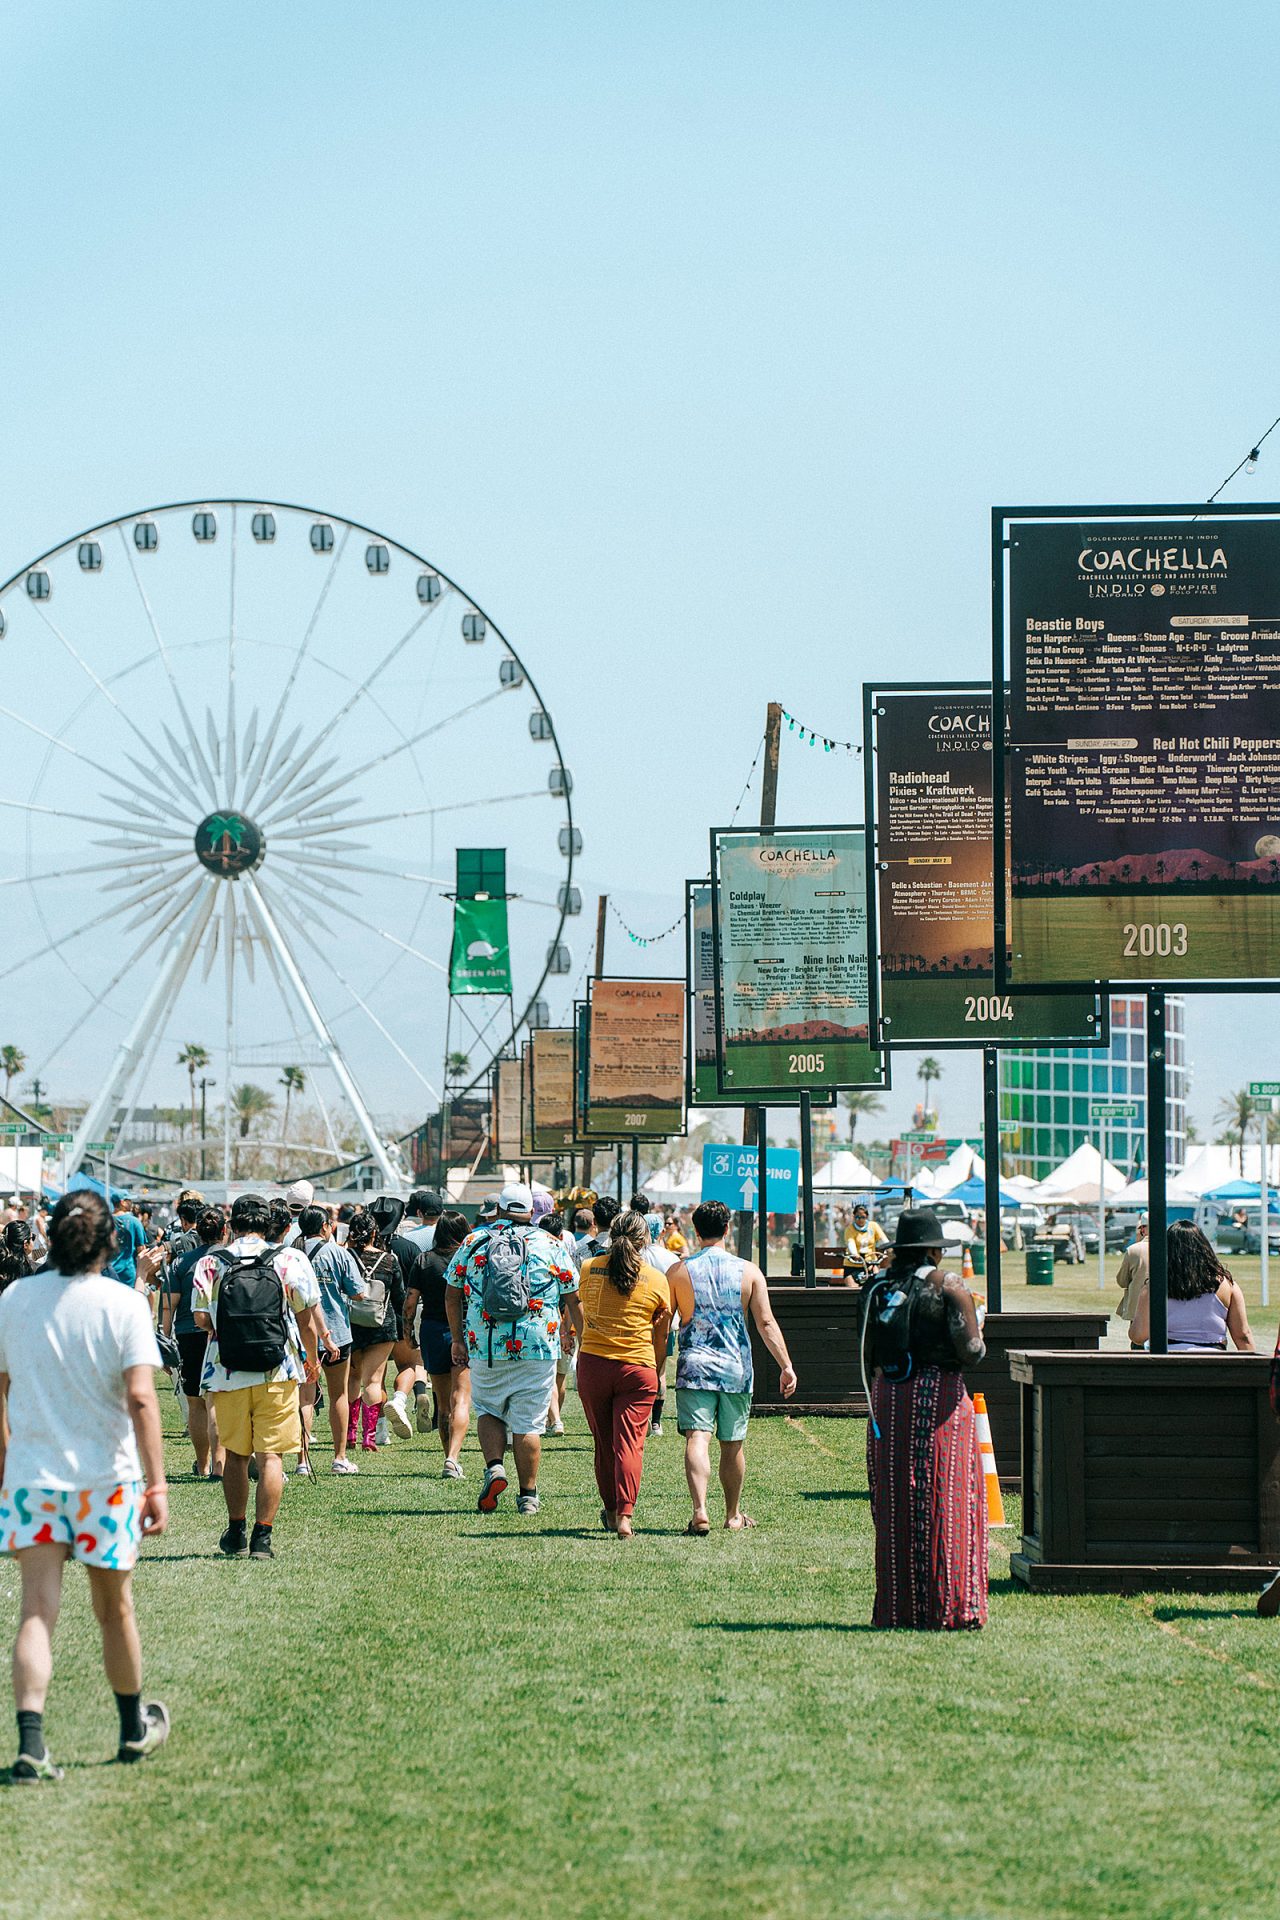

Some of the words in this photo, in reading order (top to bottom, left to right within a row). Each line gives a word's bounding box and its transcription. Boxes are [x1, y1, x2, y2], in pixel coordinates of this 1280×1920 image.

[1078, 548, 1228, 572] COACHELLA
[1089, 584, 1145, 593] INDIO
[1026, 618, 1071, 630] Beastie
[1076, 618, 1104, 632] Boys
[1044, 634, 1072, 644] Harper
[1108, 633, 1136, 642] Queens
[1144, 633, 1167, 641] Stone
[1169, 633, 1184, 642] Age
[1221, 632, 1249, 640] Groove
[1251, 632, 1280, 640] Armada
[1217, 644, 1248, 652] Ladytron
[1026, 657, 1042, 665] Felix
[1137, 656, 1156, 664] Work
[1204, 655, 1223, 663] Kinky
[1232, 654, 1253, 662] Roger
[1256, 654, 1280, 662] Sanche
[1153, 738, 1175, 750] Red
[1180, 738, 1200, 749] Hot
[1204, 737, 1229, 749] Chili
[1234, 737, 1280, 751] Peppers
[1032, 755, 1057, 763] White
[1059, 755, 1088, 765] Stripes
[1100, 755, 1116, 764] Iggy
[1124, 754, 1157, 764] Stooges
[1168, 753, 1216, 762] Underworld
[1227, 753, 1246, 761] Jack
[1248, 752, 1280, 761] Johnson
[1025, 767, 1045, 775] Sonic
[1102, 766, 1129, 774] Scream
[1140, 766, 1155, 774] Blue
[1176, 765, 1197, 774] Group
[1207, 765, 1237, 773] Thievery
[1239, 764, 1280, 773] Corporation
[890, 771, 949, 784] Radiohead
[1026, 778, 1051, 786] Interpol
[1110, 777, 1130, 785] Richie
[1131, 777, 1154, 785] Hawtin
[1205, 776, 1221, 784] Deep
[1245, 776, 1261, 784] Dirty
[890, 786, 917, 796] Pixies
[926, 785, 974, 795] Kraftwerk
[1113, 788, 1165, 796] Fischerspooner
[760, 850, 836, 862] COACHELLA
[730, 891, 765, 902] Coldplay
[1124, 923, 1188, 956] 2003
[804, 956, 823, 964] Nine
[827, 955, 844, 964] Inch
[848, 954, 868, 963] Nails
[615, 990, 662, 998] COACHELLA
[965, 996, 1014, 1021] 2004
[789, 1054, 825, 1073] 2005
[625, 1114, 647, 1126] 2007
